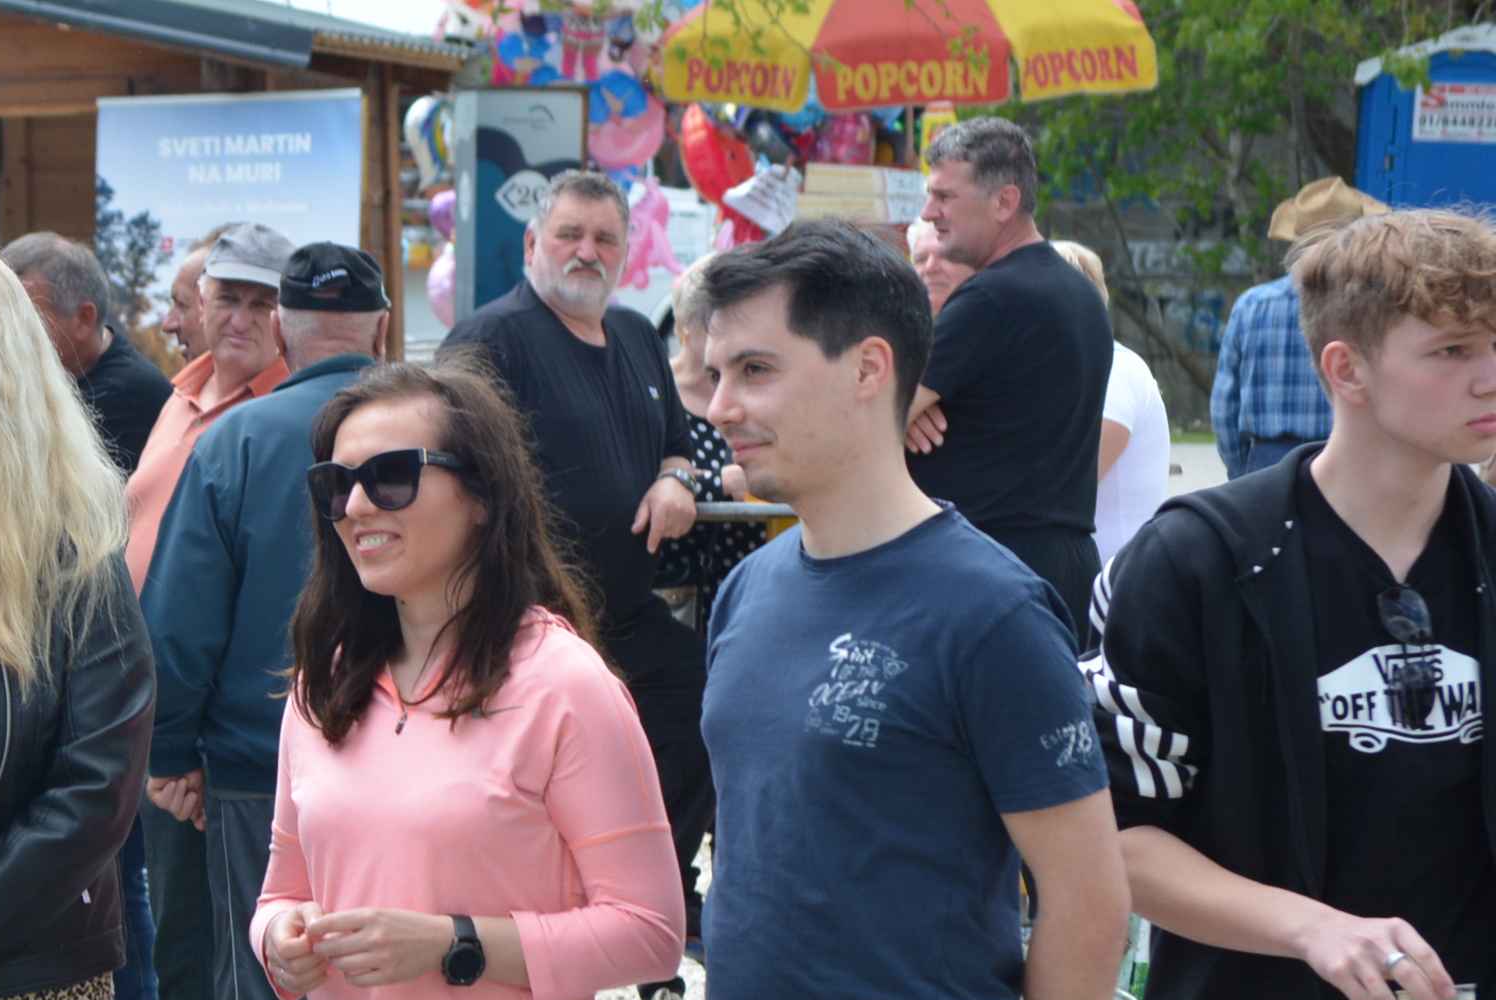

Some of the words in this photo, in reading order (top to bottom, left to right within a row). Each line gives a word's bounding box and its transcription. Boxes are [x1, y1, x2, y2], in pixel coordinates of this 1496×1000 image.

[836, 59, 990, 100] POPCORN
[158, 136, 221, 158] SVETI
[224, 132, 312, 154] MARTIN
[188, 162, 222, 184] NA
[226, 160, 281, 183] MURI
[1372, 650, 1444, 685] VAS
[1435, 681, 1478, 727] WA
